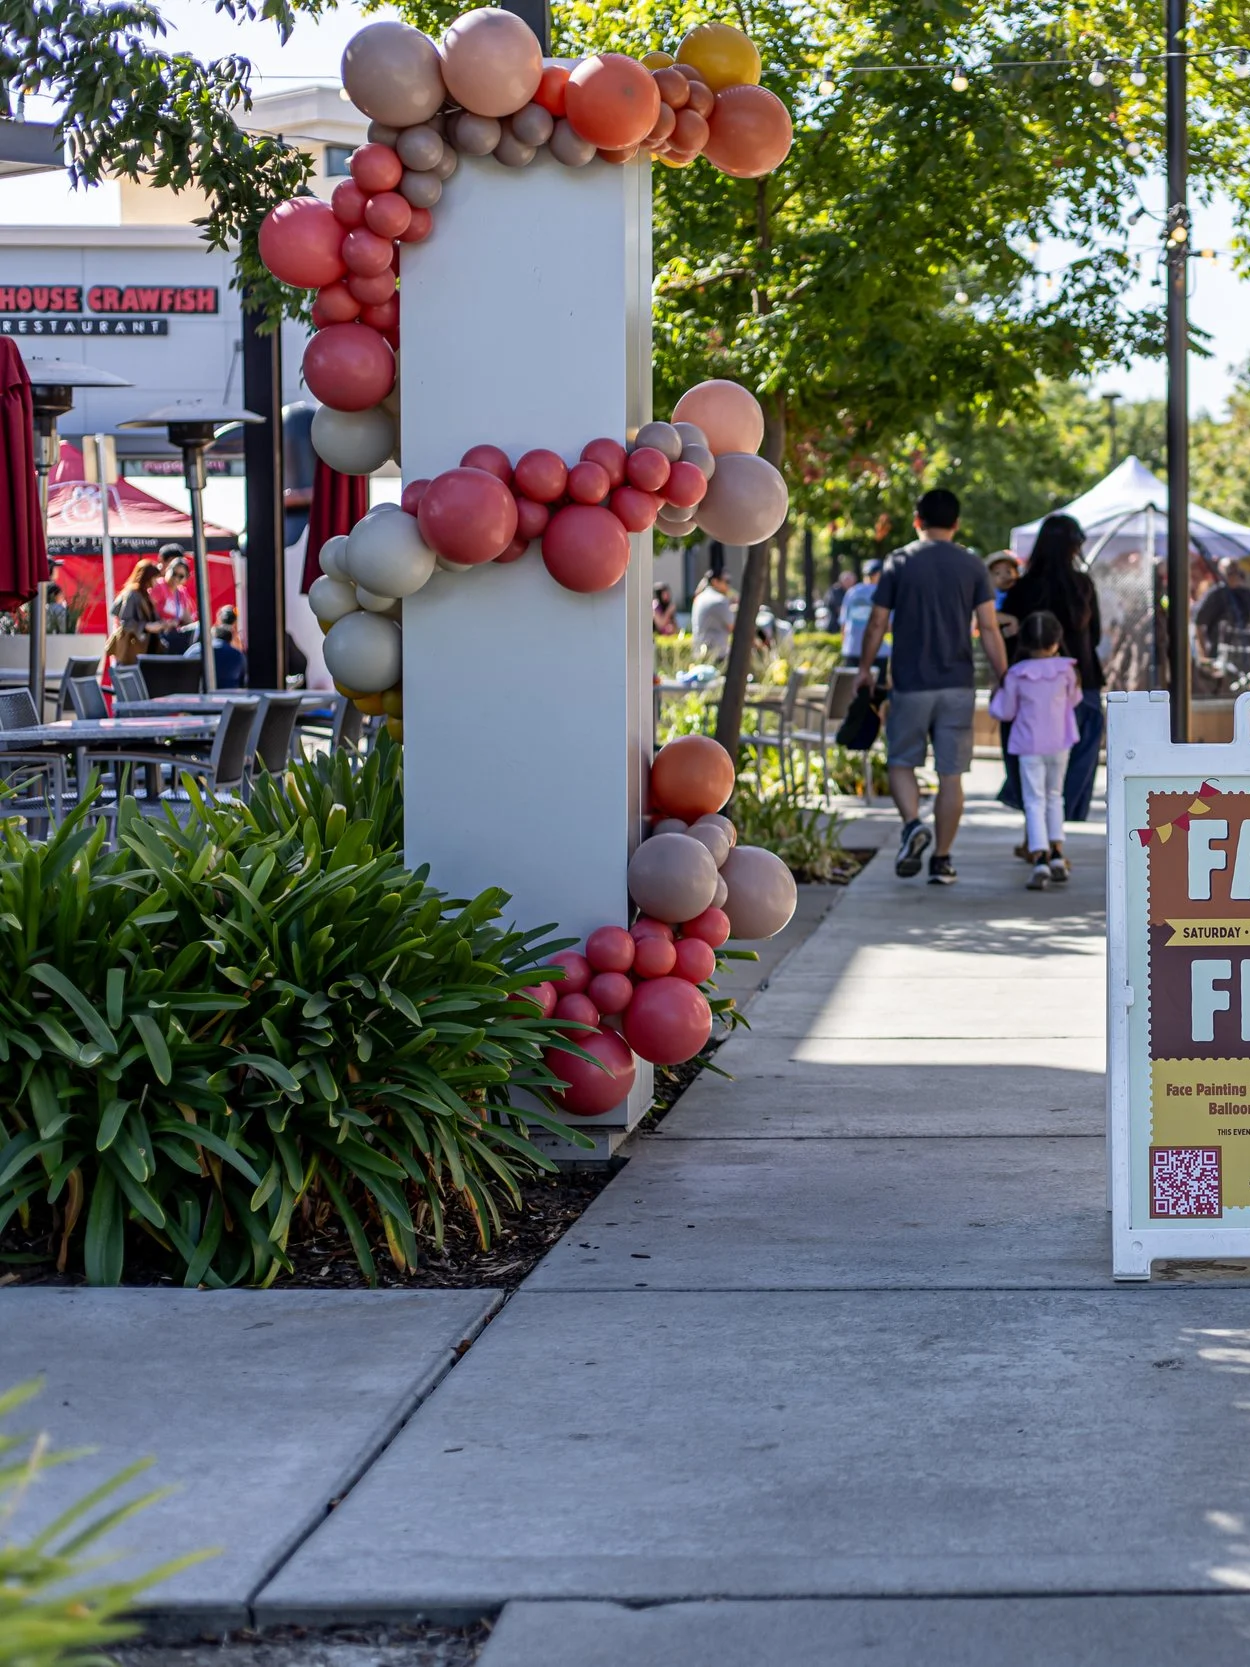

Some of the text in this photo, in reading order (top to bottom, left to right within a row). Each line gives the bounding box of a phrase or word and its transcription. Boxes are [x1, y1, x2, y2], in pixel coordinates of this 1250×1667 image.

[2, 320, 161, 334] RESTAURANT
[1183, 926, 1241, 938] SATURDAY
[1166, 1083, 1193, 1097] Face
[1196, 1083, 1247, 1097] Painting
[1217, 1128, 1232, 1136] THIS
